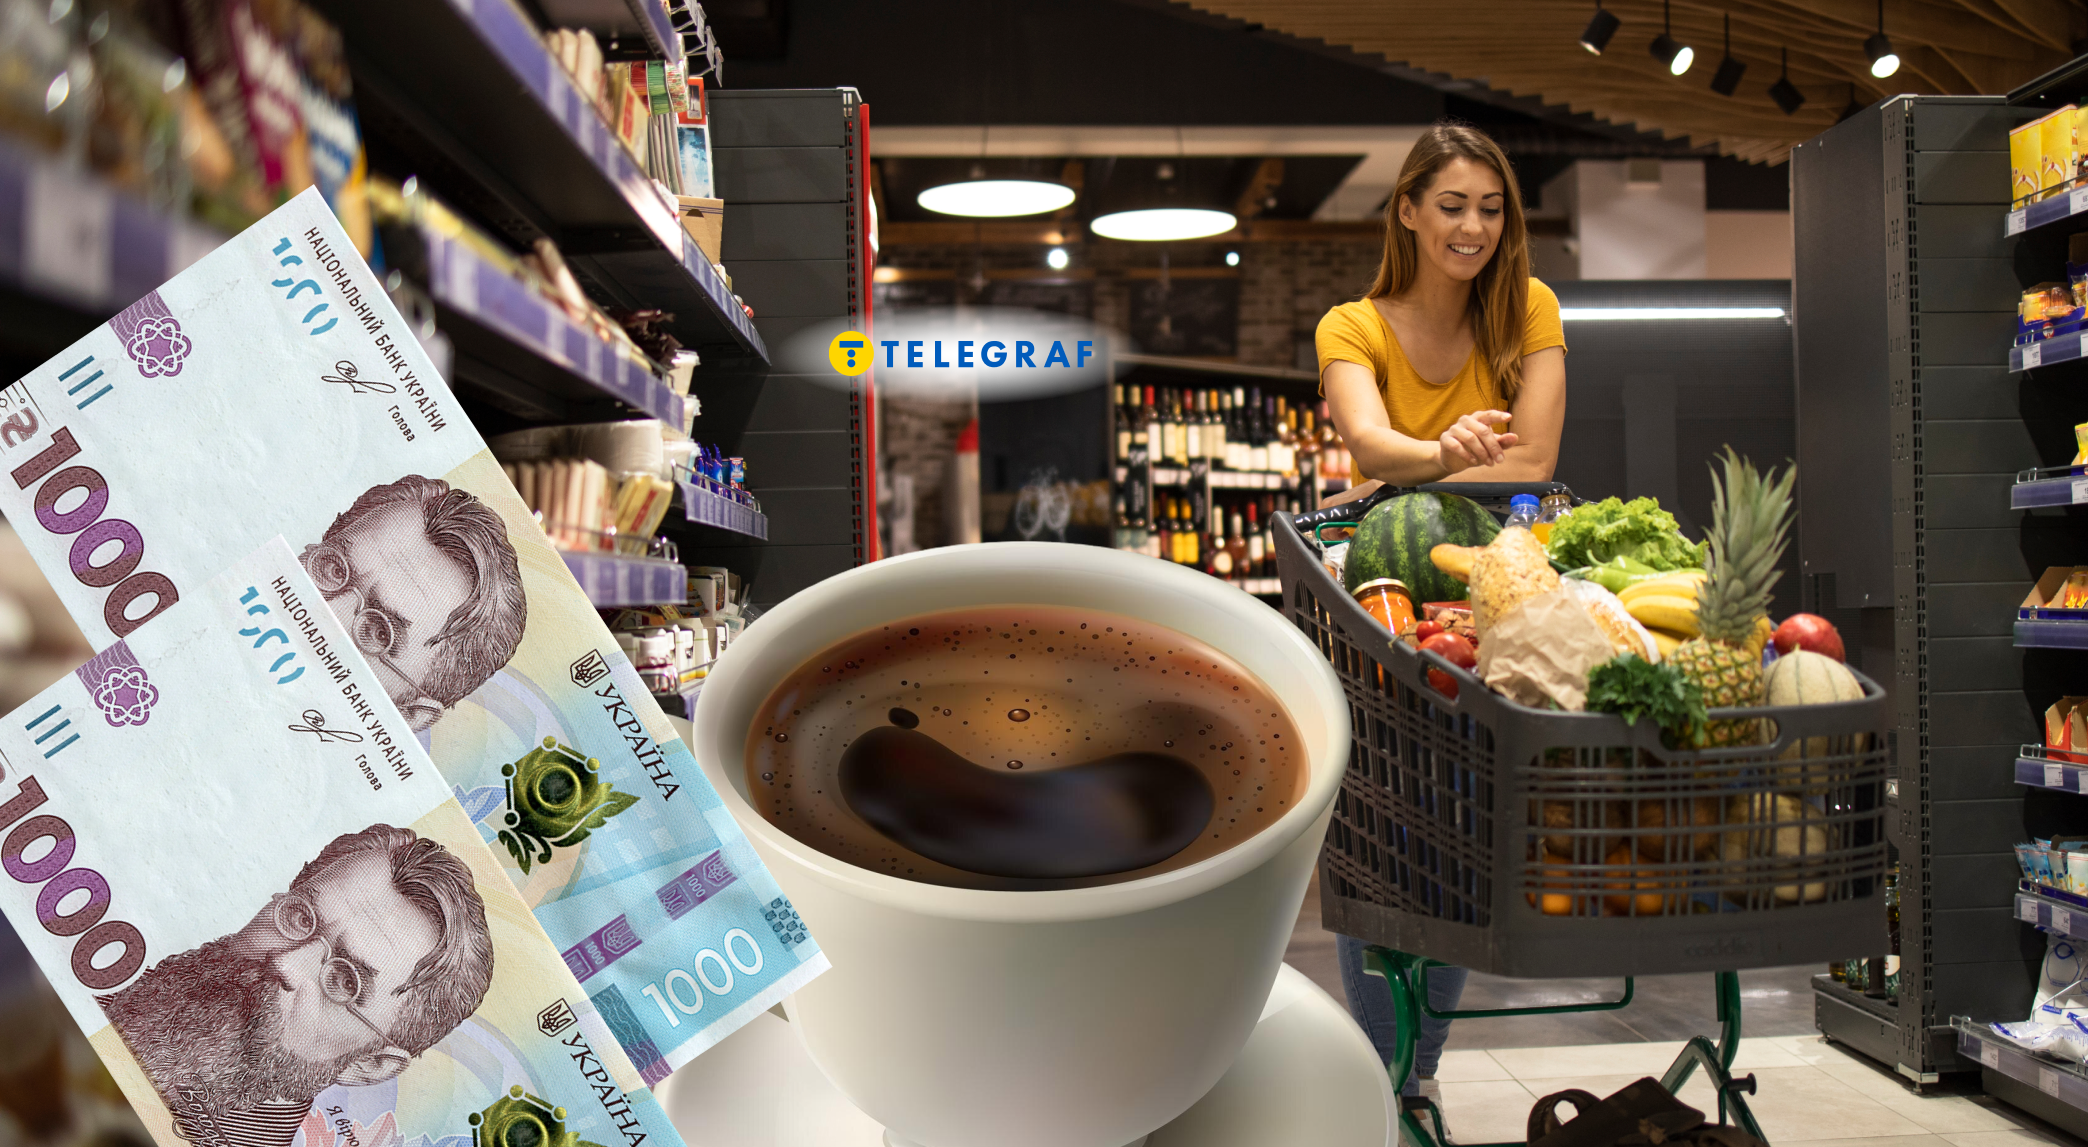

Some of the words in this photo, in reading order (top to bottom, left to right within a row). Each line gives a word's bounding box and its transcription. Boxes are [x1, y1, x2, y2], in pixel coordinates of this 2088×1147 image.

[304, 226, 385, 335] НАЦІОНАЛЬНИЙ
[375, 333, 407, 373] БАНК
[400, 371, 446, 432] УКРАЇНИ
[388, 405, 415, 442] Голова
[10, 425, 179, 638] 1000
[271, 575, 352, 684] НАЦІОНАЛЬНИЙ
[342, 683, 375, 723] БАНК
[367, 720, 413, 782] УКРАЇНИ
[355, 754, 382, 791] Голова
[594, 682, 680, 802] УКРАЇНА
[0, 774, 147, 990] 1000
[685, 874, 706, 898] 1000
[585, 941, 605, 965] 1000
[640, 925, 765, 1029] 1000
[326, 1105, 344, 1116] Я
[335, 1118, 360, 1147] вірю
[561, 1031, 647, 1147] УКРАЇНА
